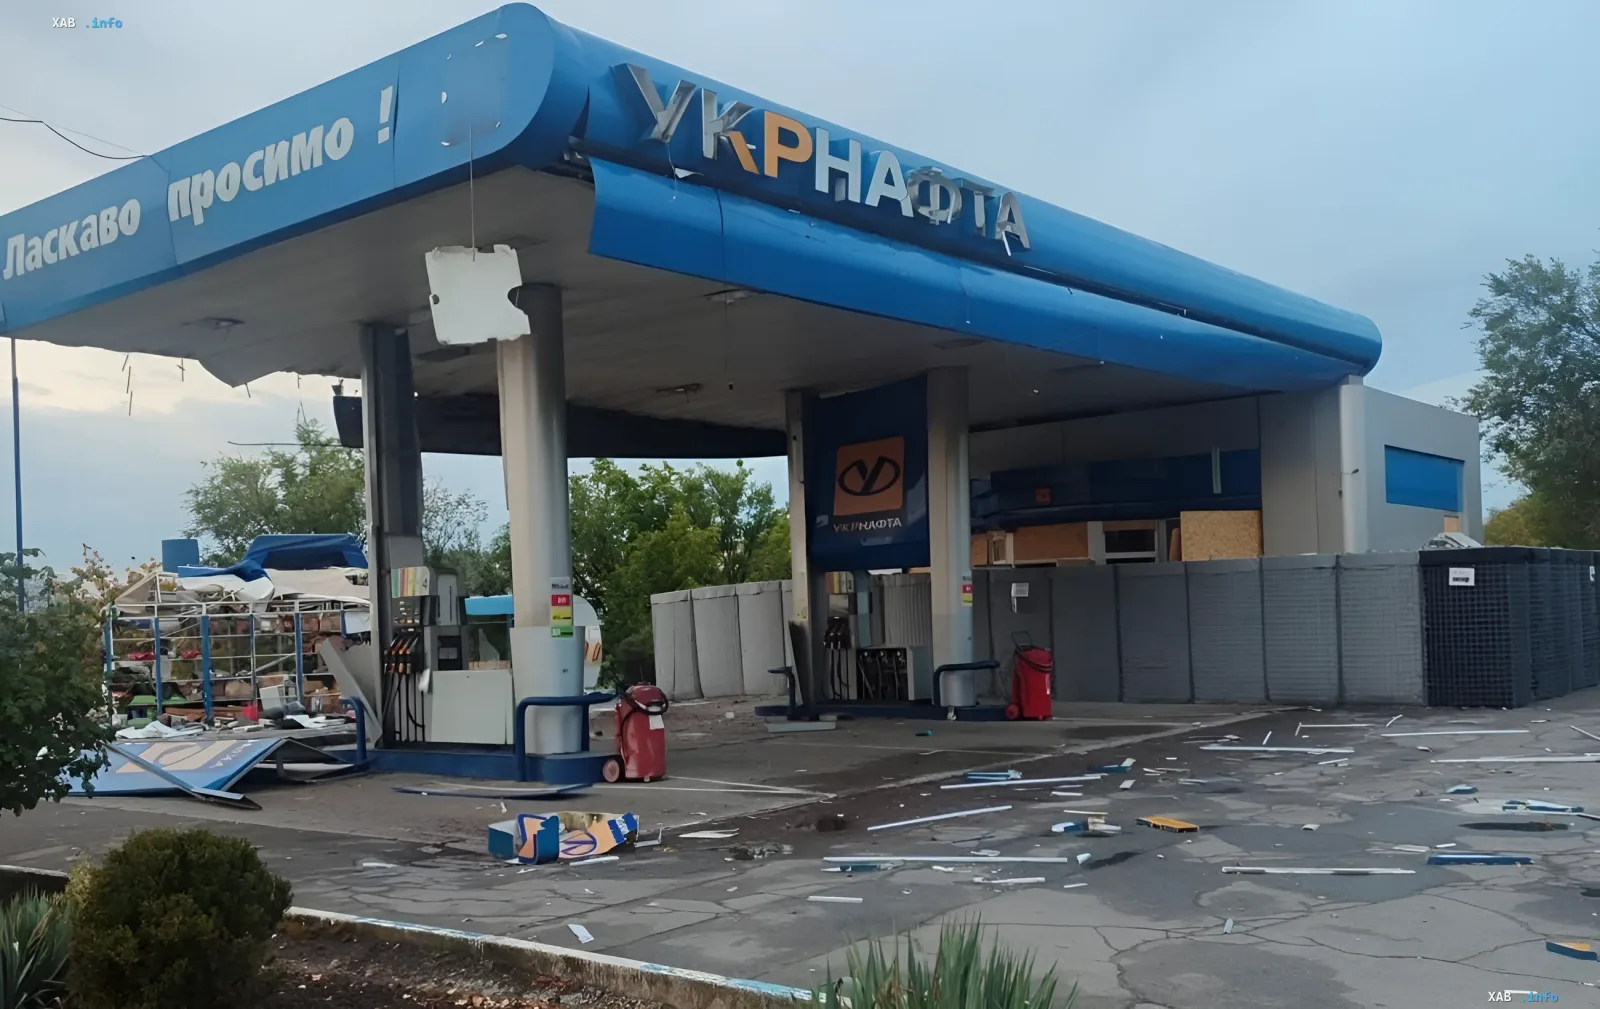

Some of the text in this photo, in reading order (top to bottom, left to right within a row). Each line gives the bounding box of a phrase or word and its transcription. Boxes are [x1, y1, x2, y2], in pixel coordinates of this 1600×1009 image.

[3, 85, 393, 280] Ласкаво просимо !
[610, 63, 1031, 249] УКРНАФТА
